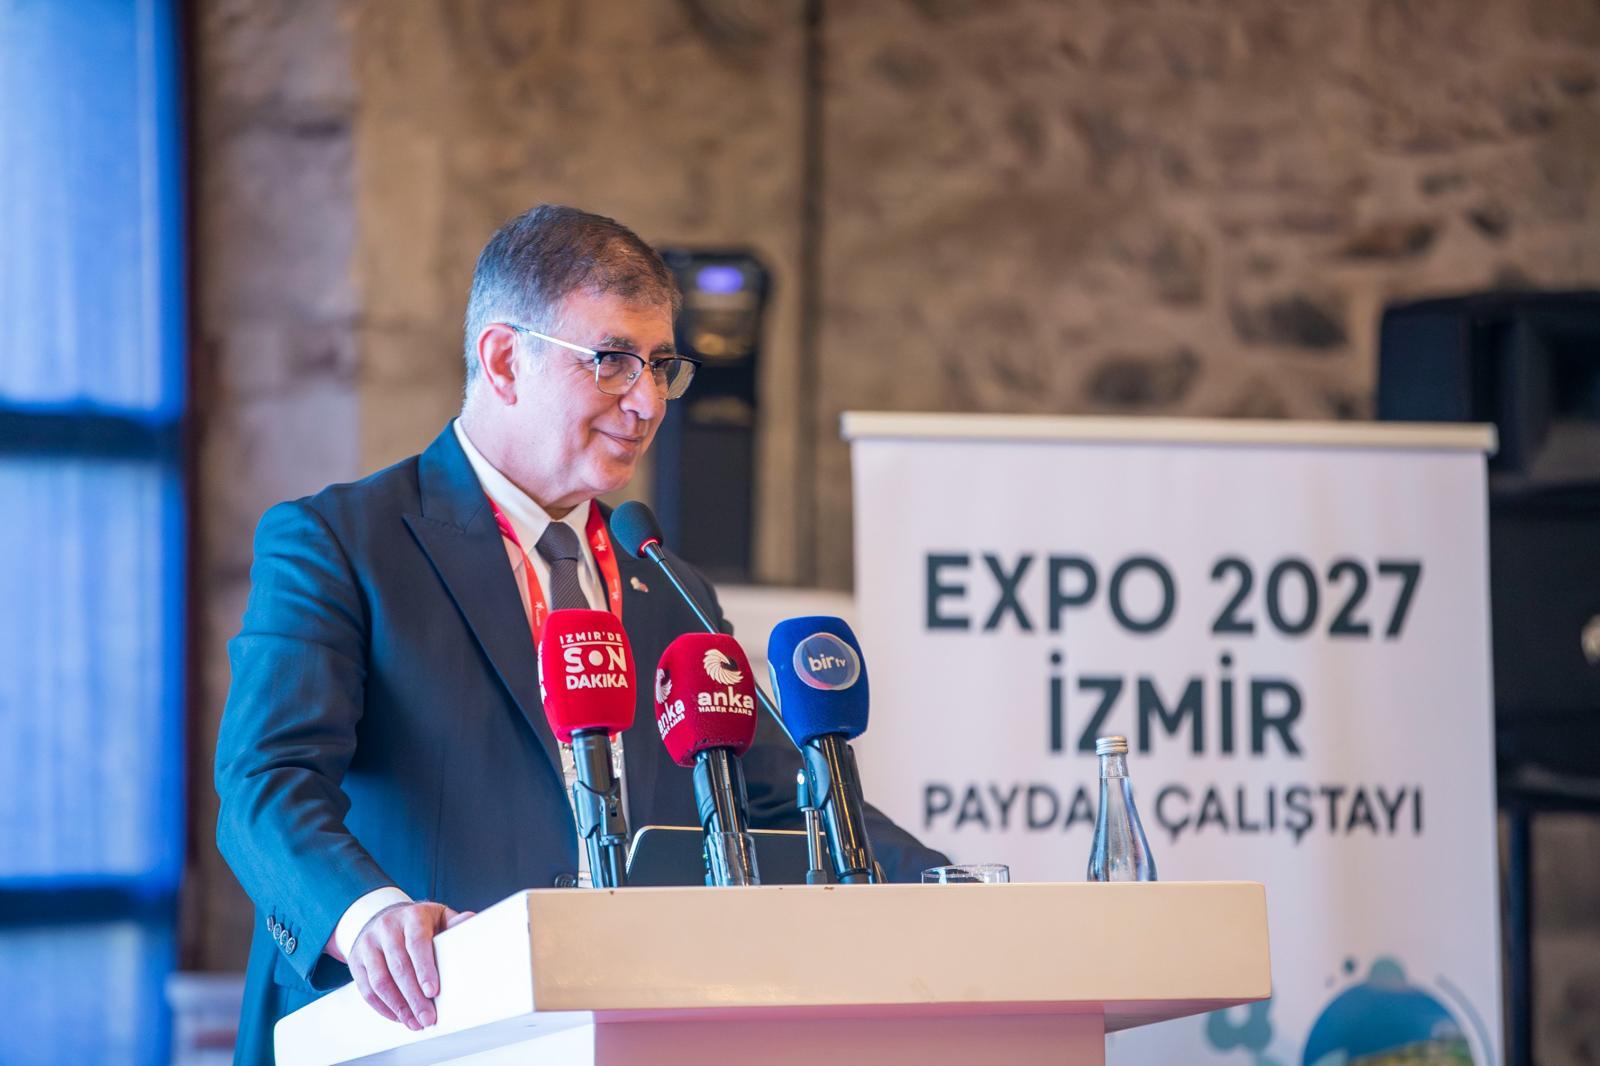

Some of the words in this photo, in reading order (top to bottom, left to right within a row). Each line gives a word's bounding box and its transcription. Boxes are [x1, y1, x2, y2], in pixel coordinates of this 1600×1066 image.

[925, 552, 1178, 636] EXPO
[1210, 555, 1425, 640] 2027
[808, 653, 834, 672] bir
[697, 685, 755, 710] anka
[698, 706, 727, 714] HABER
[1048, 650, 1306, 758] İZMİR
[923, 784, 1096, 831] PAYDA
[1153, 784, 1425, 846] ÇALIŞTAYI
